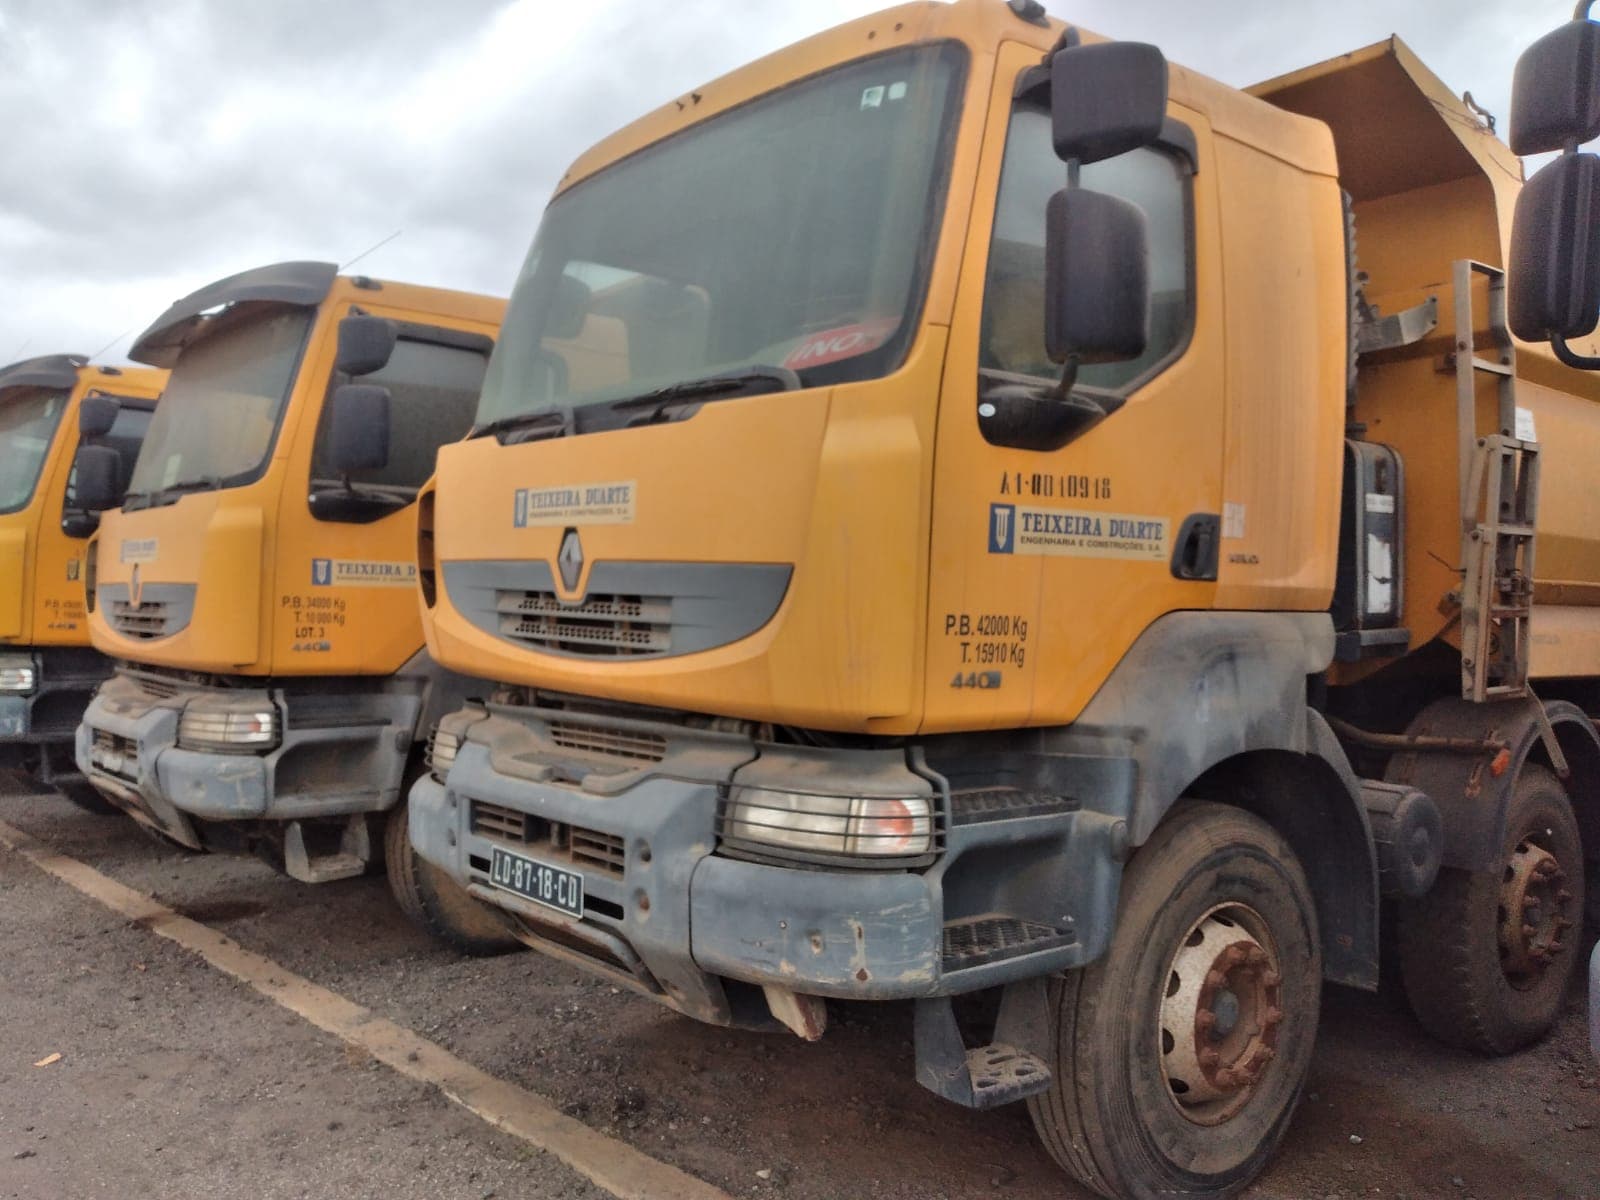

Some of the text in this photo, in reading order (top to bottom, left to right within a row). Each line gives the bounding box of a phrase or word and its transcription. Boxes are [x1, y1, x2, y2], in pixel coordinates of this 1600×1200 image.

[531, 486, 630, 509] TEIXEIRA DUARTE
[1022, 512, 1163, 541] TEIXEIRA DUARTE
[1020, 536, 1076, 547] ENGENHARIA
[1079, 539, 1084, 547] E
[337, 562, 402, 576] TEIXEIRA
[334, 597, 346, 611] Kg
[333, 612, 345, 626] Kg
[319, 627, 325, 638] 3
[945, 614, 1027, 641] P.B. 42000 Kg
[960, 642, 1025, 668] T. 15910 Kg
[950, 671, 990, 688] 440
